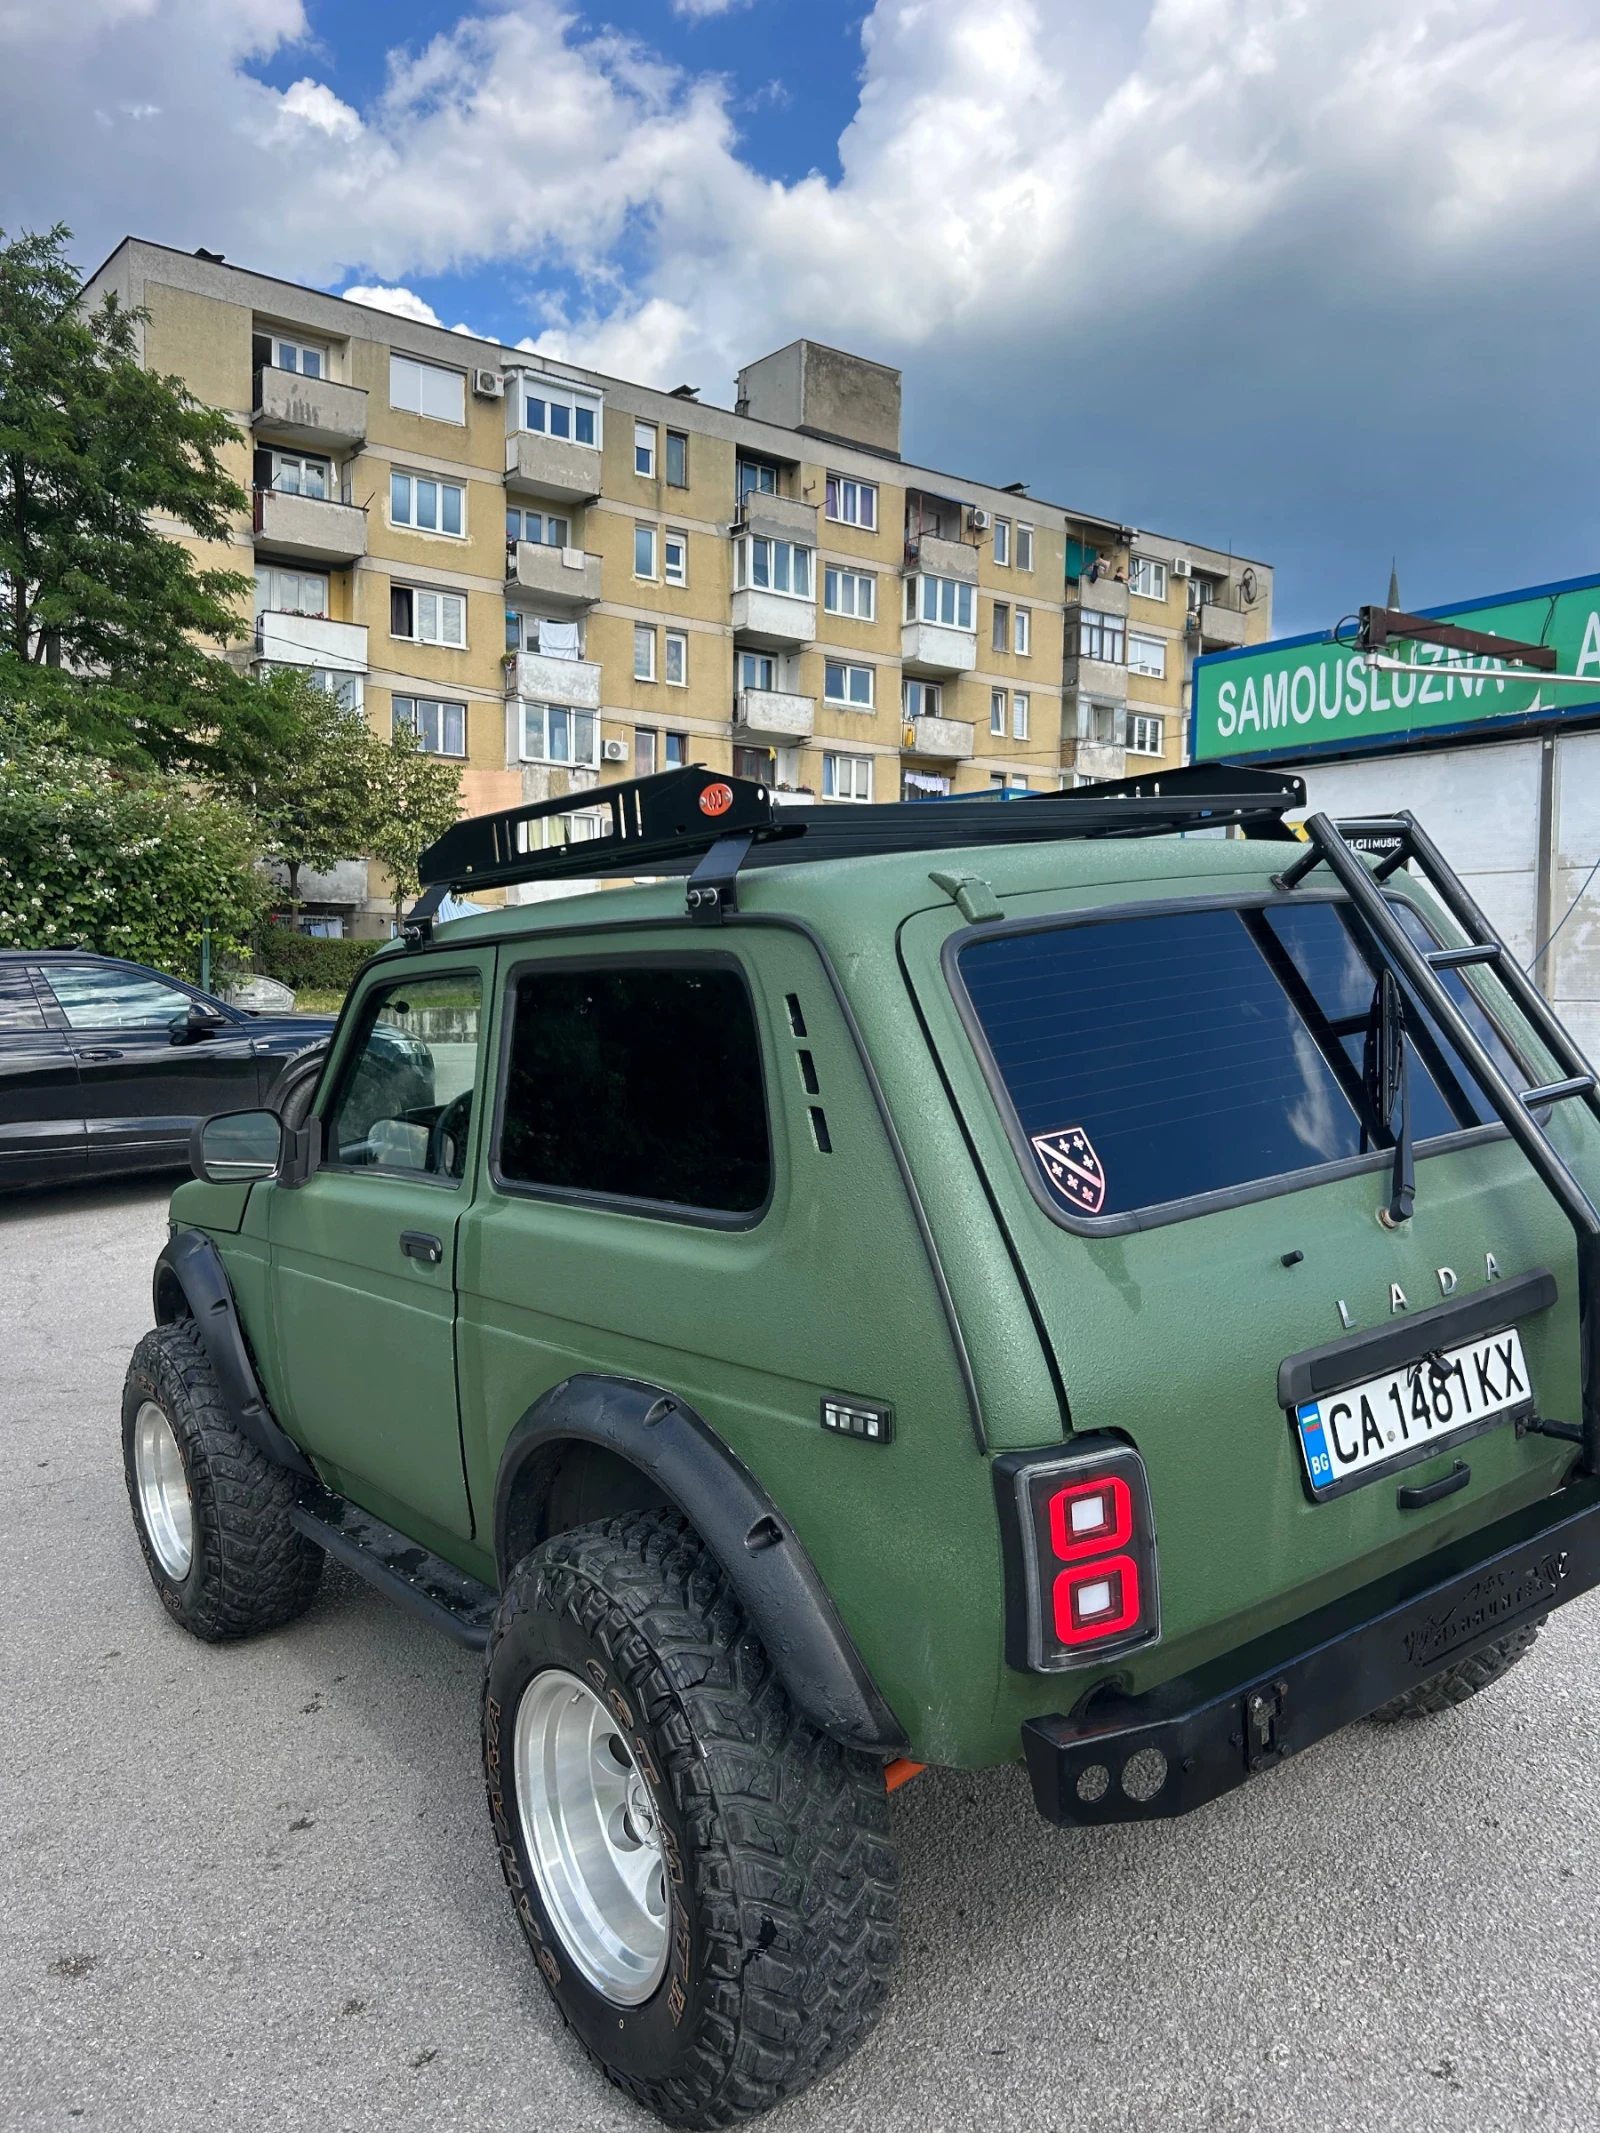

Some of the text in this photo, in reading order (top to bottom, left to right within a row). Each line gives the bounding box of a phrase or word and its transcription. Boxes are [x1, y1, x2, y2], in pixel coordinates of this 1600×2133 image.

[1335, 1252, 1503, 1330] LADA
[1310, 1453, 1330, 1476] BG
[486, 1696, 561, 1987] SAHARA
